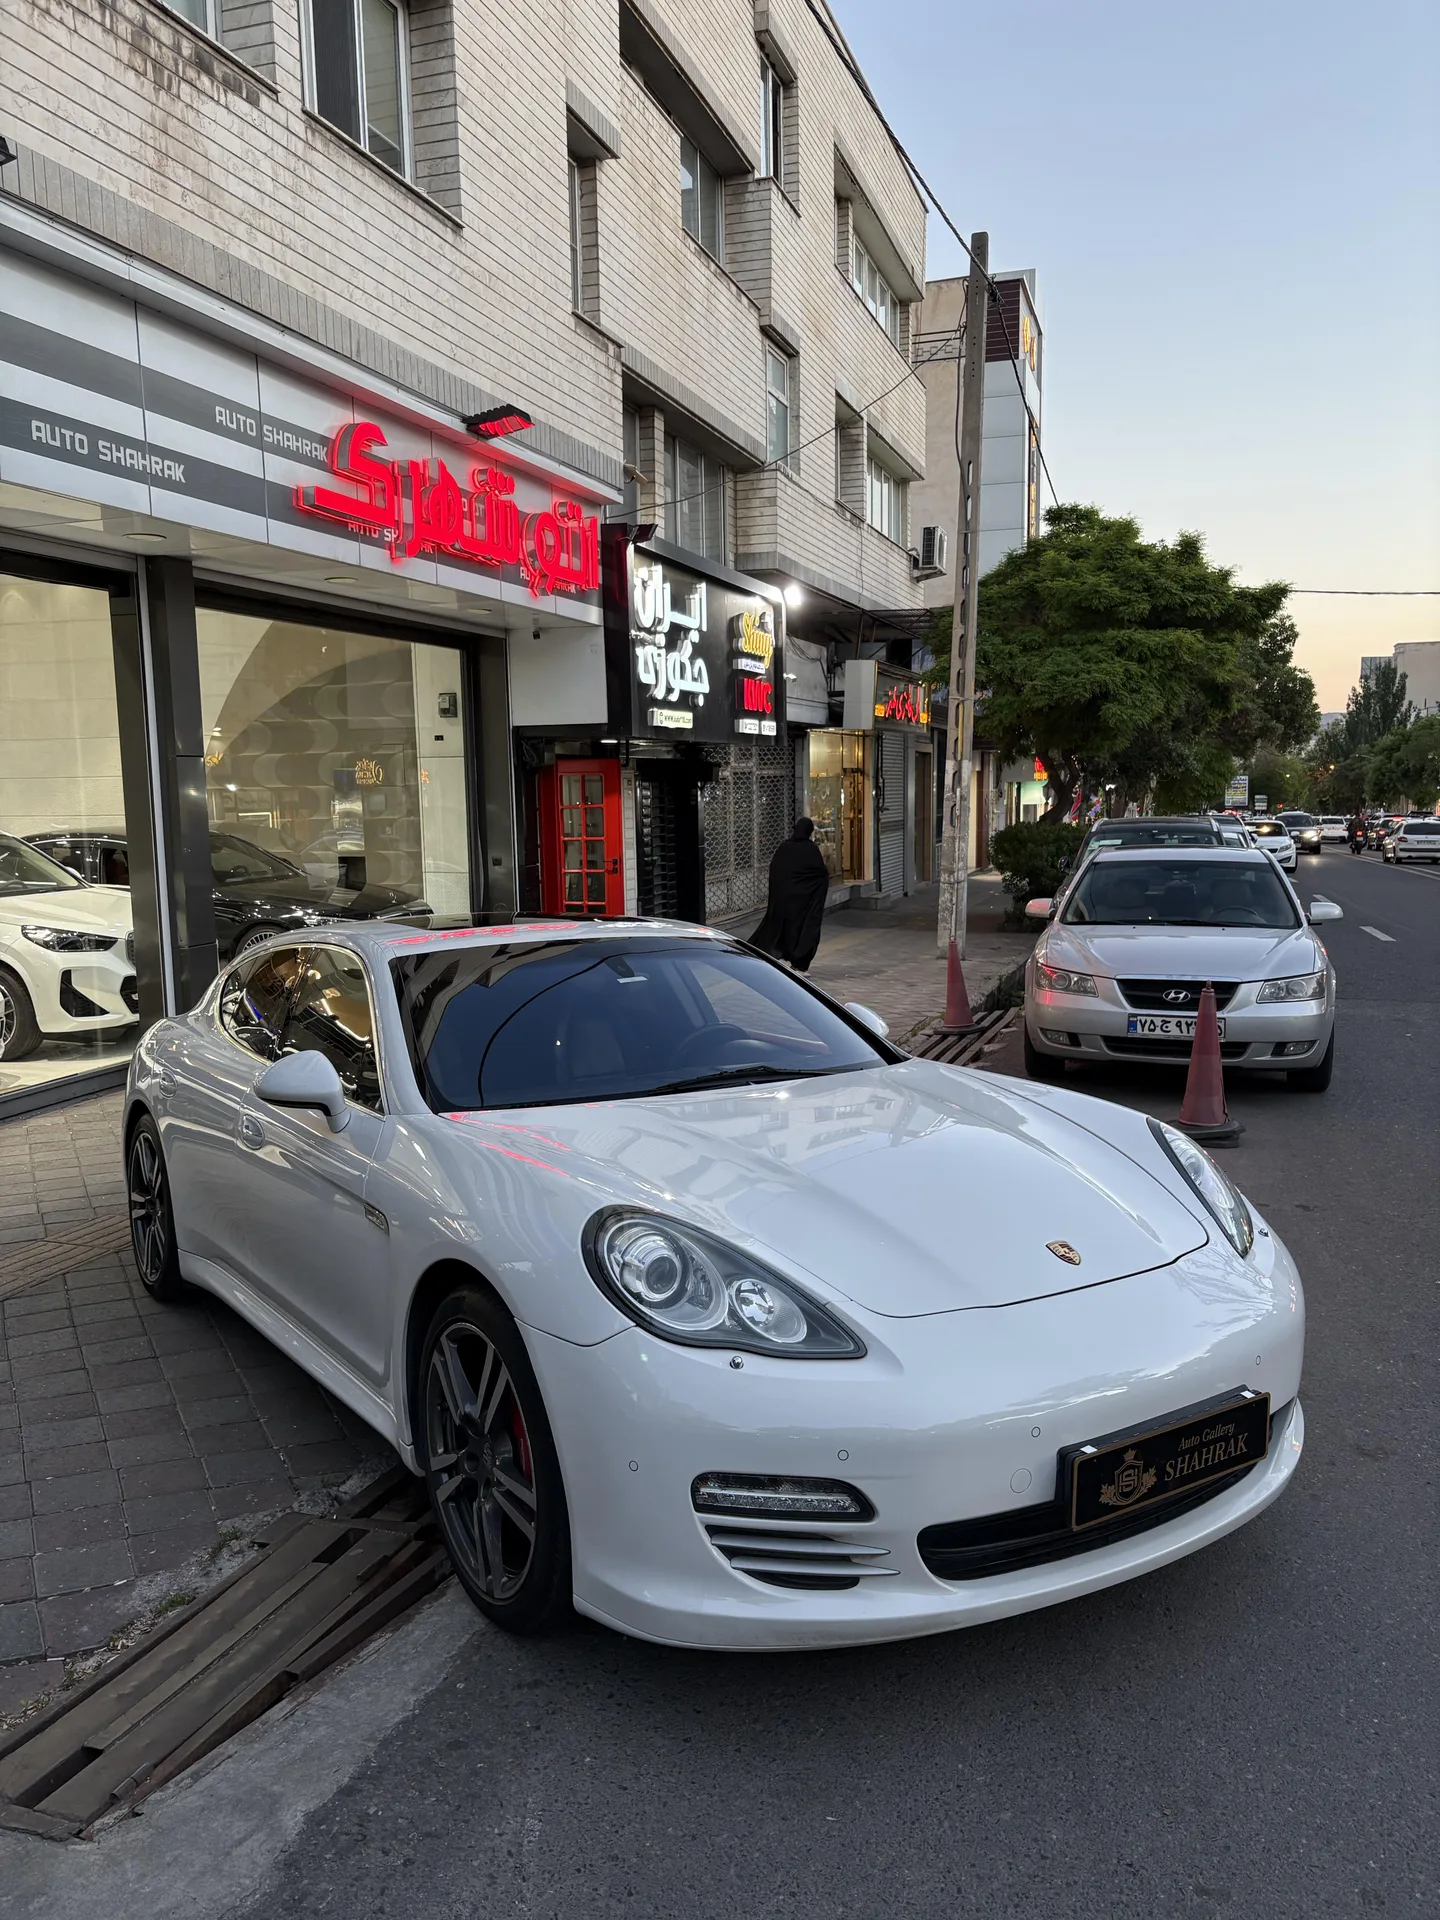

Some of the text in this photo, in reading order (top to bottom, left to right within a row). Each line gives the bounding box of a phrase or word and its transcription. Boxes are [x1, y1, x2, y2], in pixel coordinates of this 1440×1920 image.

[30, 419, 187, 483] AUTO SHAHRAK
[214, 405, 329, 463] AUTO SHAHRAK
[523, 498, 599, 597] اتو
[634, 564, 708, 642] ایران
[1164, 1433, 1249, 1481] SHAHRAK
[1178, 1421, 1235, 1451] Auto Gallery
